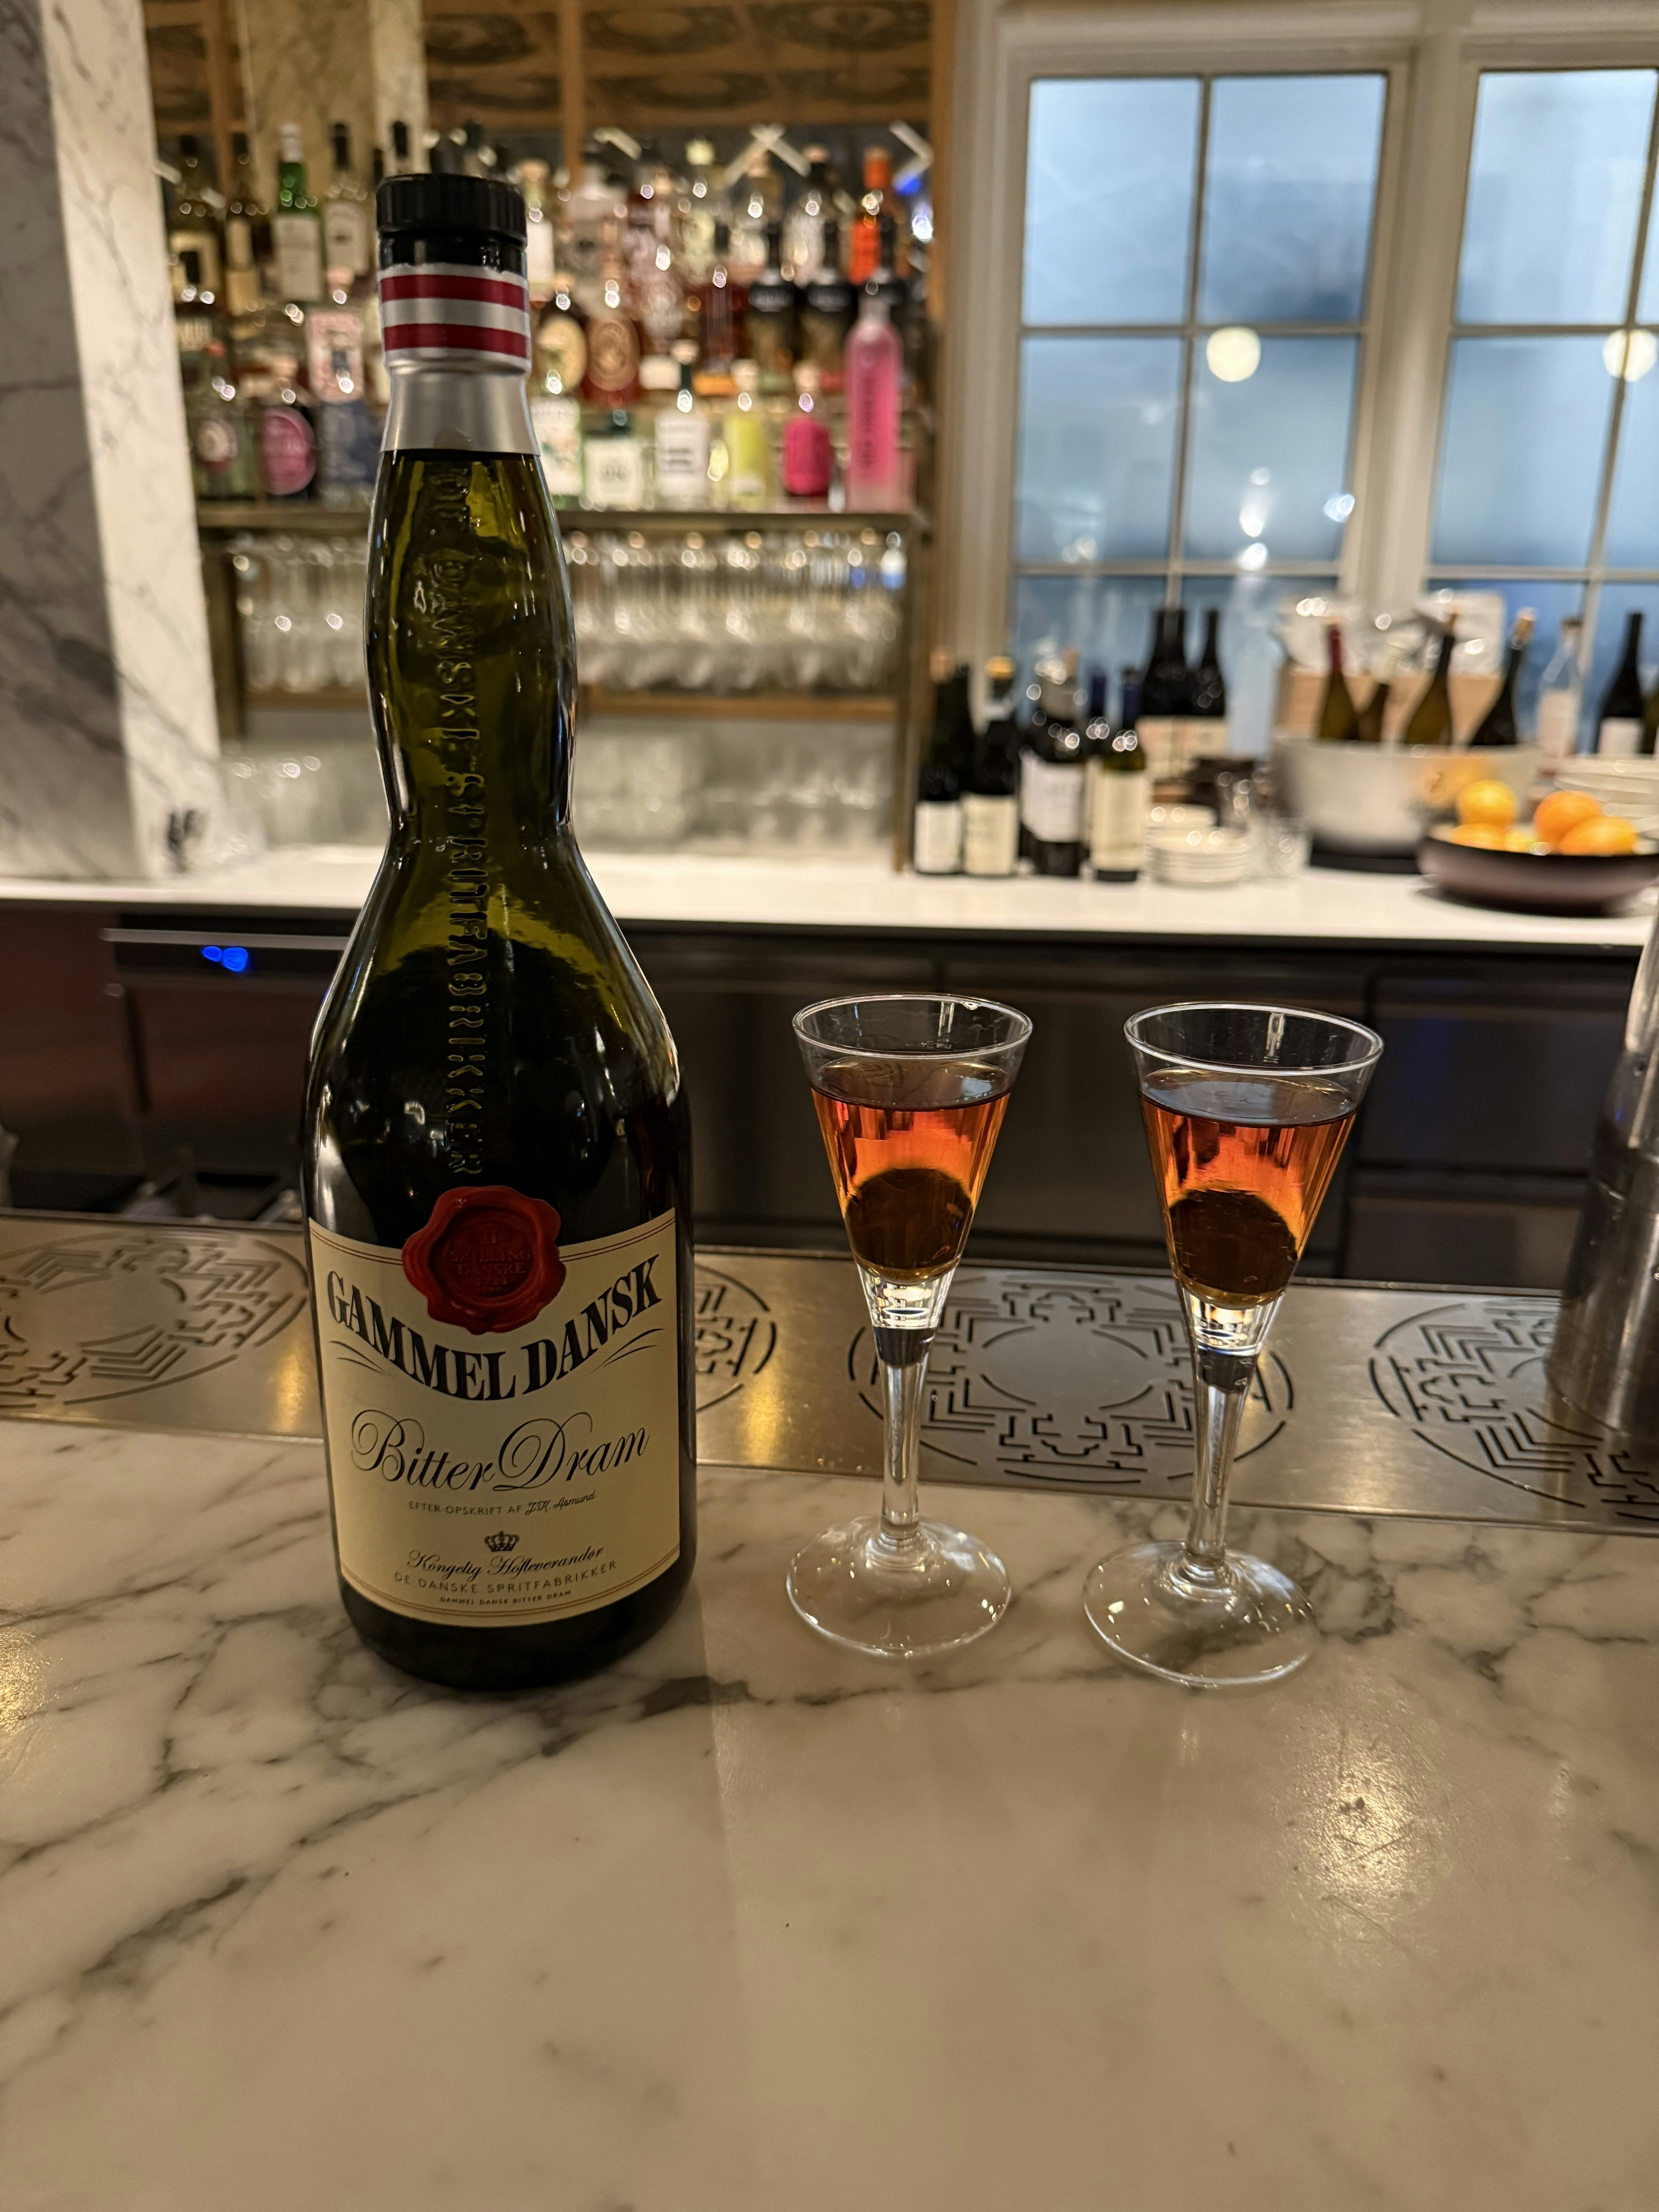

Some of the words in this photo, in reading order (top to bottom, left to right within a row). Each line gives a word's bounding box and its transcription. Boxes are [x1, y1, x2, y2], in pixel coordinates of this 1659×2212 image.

[326, 1271, 517, 1401] GAMMEL
[520, 1254, 663, 1395] DANSK
[351, 1410, 495, 1492] Bitter
[493, 1412, 650, 1492] Dram
[409, 1500, 441, 1513] EFTER
[446, 1505, 503, 1515] OPSKRIFT
[508, 1504, 522, 1514] AF
[554, 1488, 597, 1510] Asmund
[394, 1571, 410, 1585] DE
[419, 1578, 479, 1593] DANSKE
[487, 1560, 617, 1594] SPRITFABRIKKER
[406, 1549, 483, 1582] Kongelig
[440, 1596, 474, 1605] GAMMEL
[513, 1595, 542, 1604] BITTER
[546, 1589, 571, 1600] DRAM
